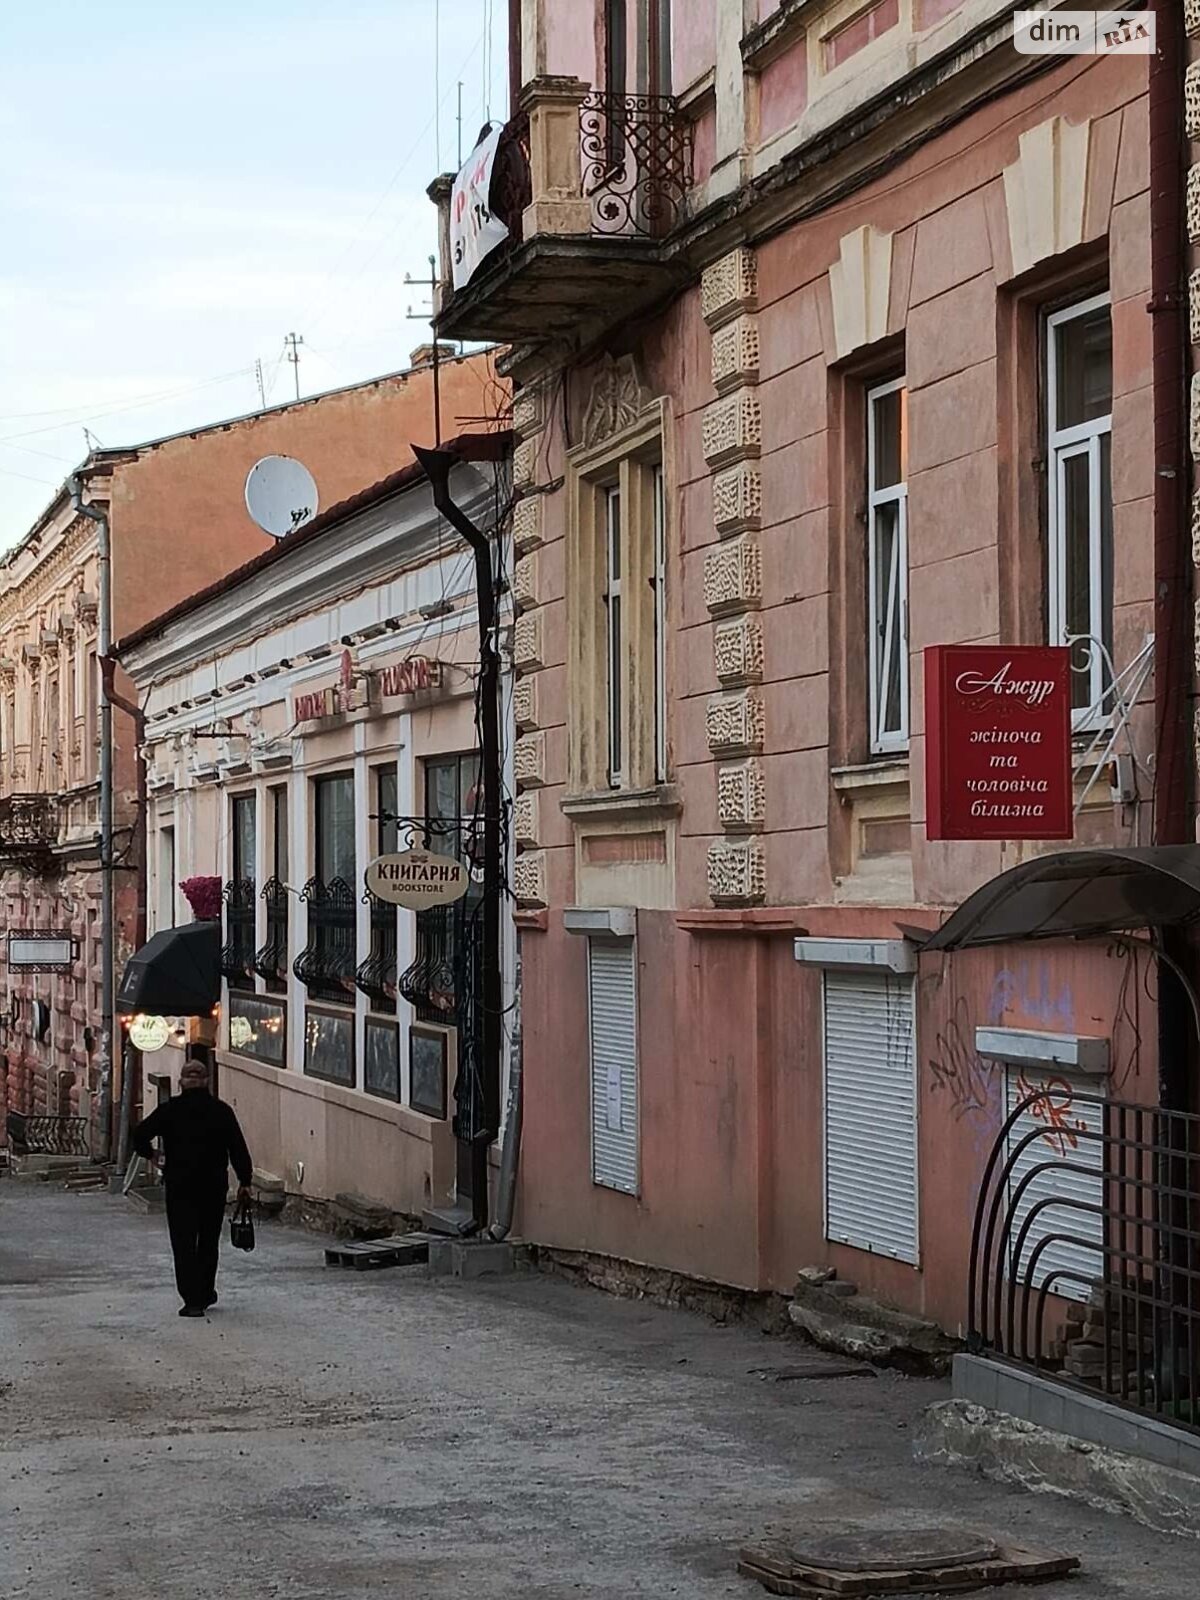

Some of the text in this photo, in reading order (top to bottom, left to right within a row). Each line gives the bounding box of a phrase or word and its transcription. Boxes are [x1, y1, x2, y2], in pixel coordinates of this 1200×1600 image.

[955, 661, 1055, 704] Ажур
[970, 726, 1042, 744] жіноча
[989, 754, 1018, 768] та
[966, 775, 1049, 793] чоловіча
[970, 799, 1045, 817] білизна
[377, 863, 460, 881] КНИГАРНЯ
[392, 883, 445, 893] BOOKSTORE
